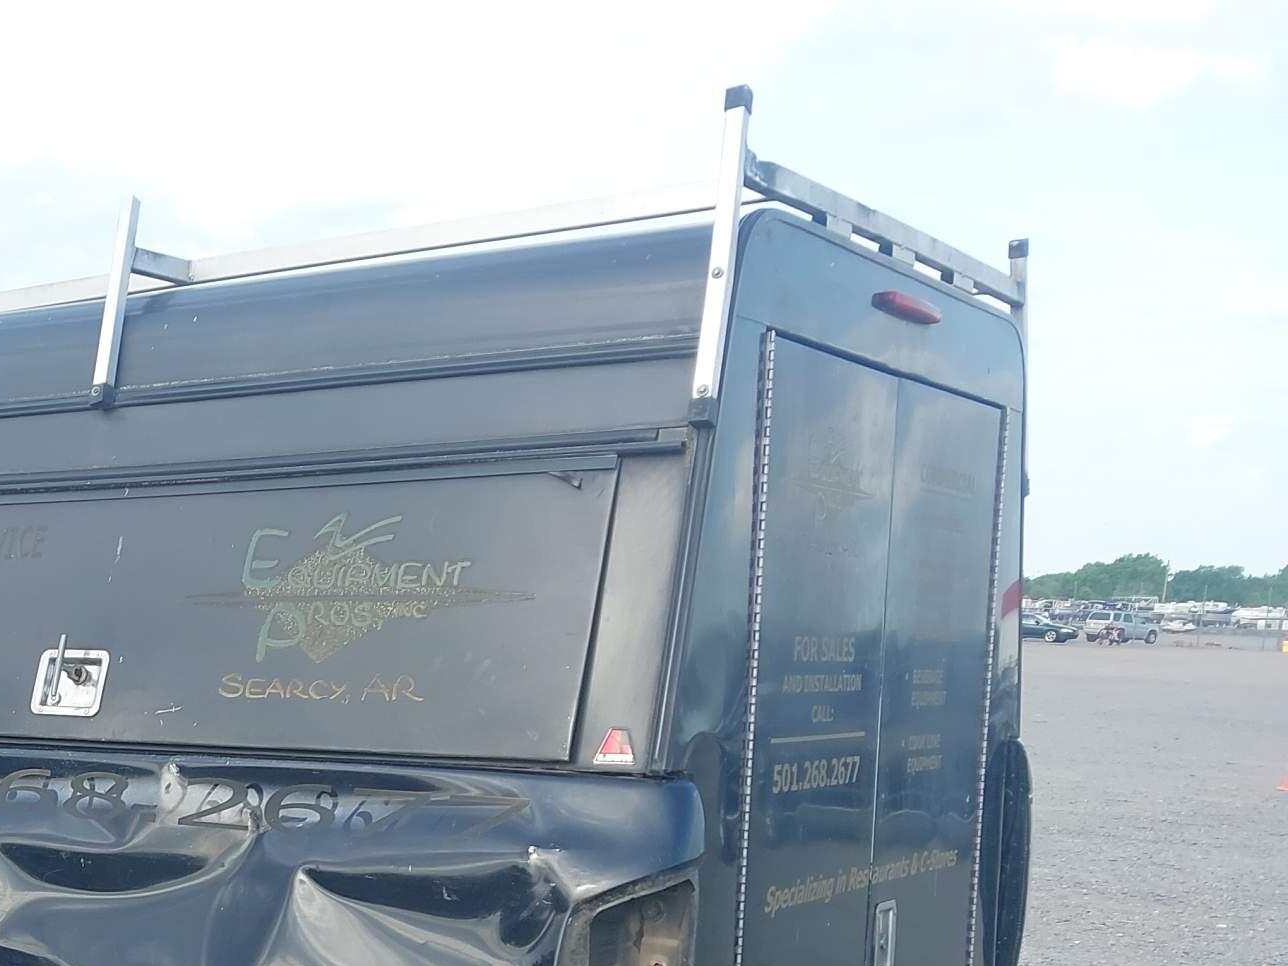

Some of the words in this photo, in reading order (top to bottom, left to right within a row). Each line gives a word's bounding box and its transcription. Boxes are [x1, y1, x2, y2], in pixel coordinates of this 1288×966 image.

[241, 528, 472, 590] EQUIPMENT
[793, 635, 819, 662] FOR
[821, 636, 857, 662] SALES
[217, 672, 351, 705] SEARCY,
[361, 673, 425, 702] AR
[772, 755, 861, 794] 501.268.2677
[764, 872, 834, 918] Specializing
[835, 868, 848, 894] in
[847, 856, 911, 893] Restaurants
